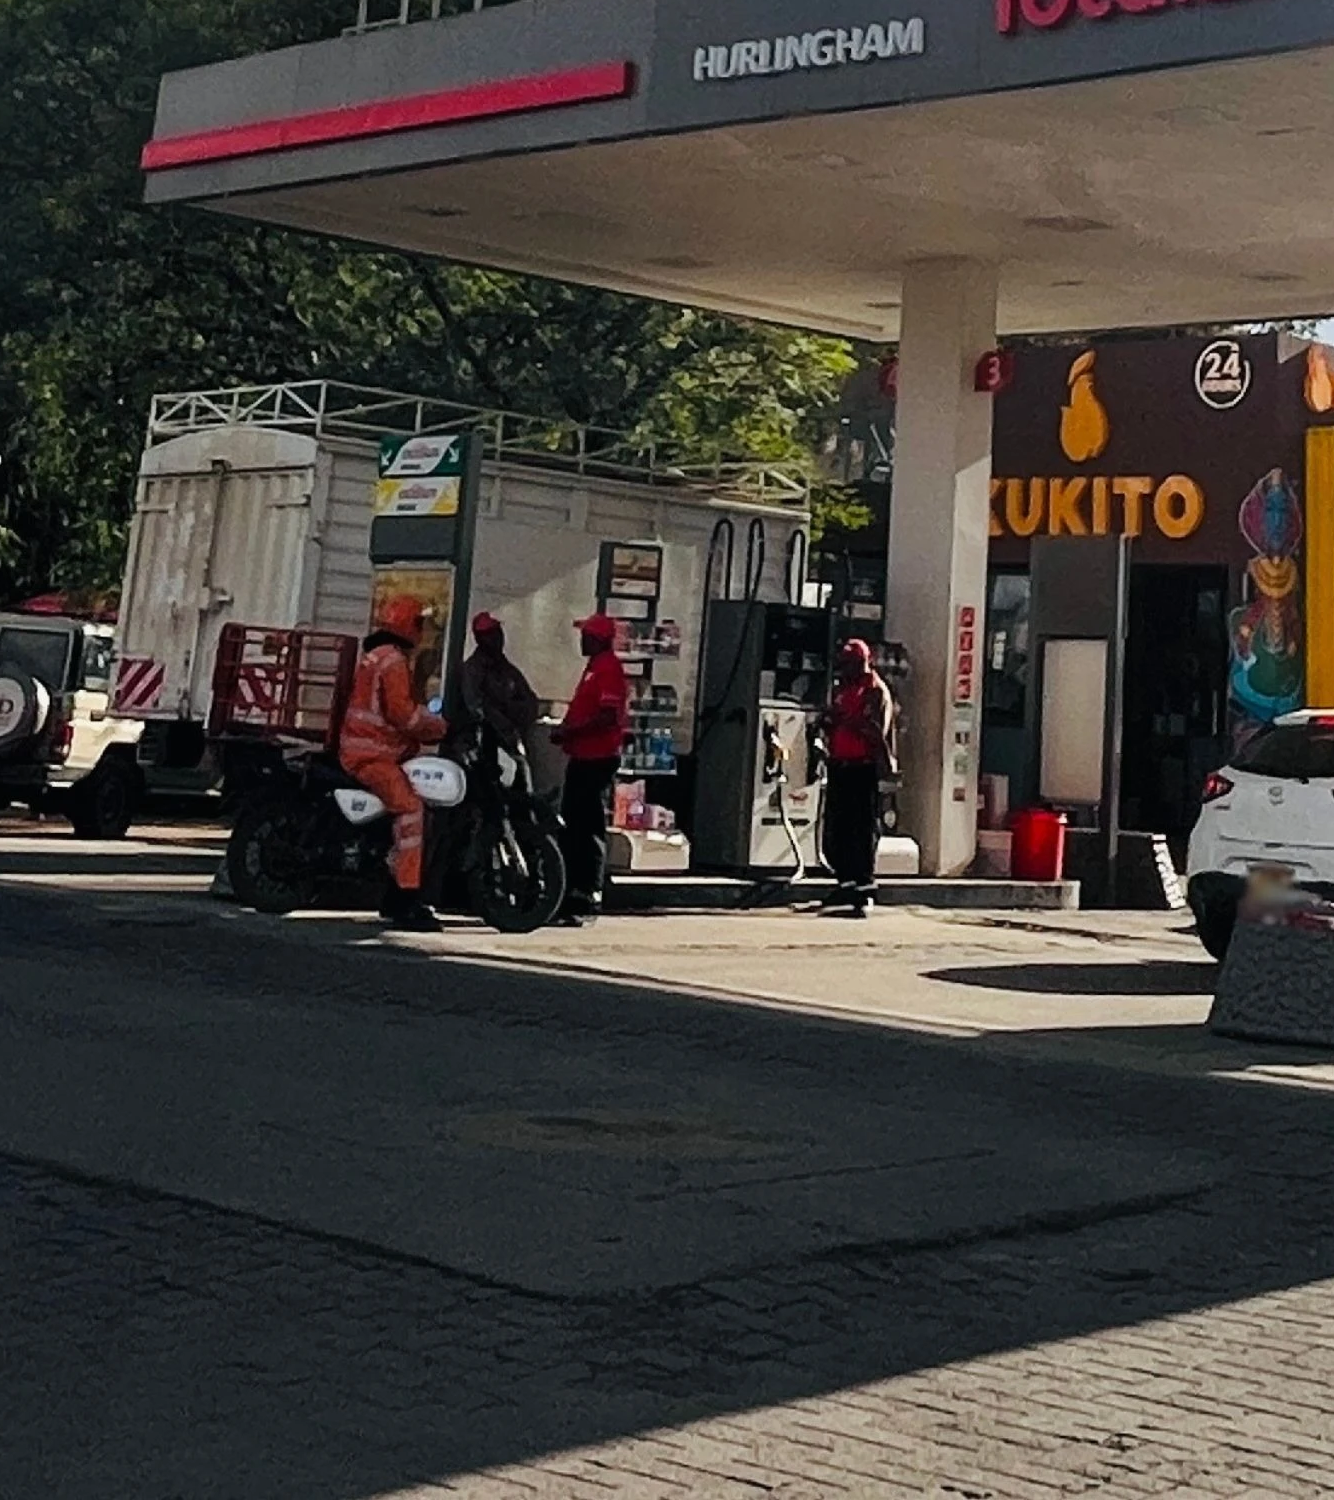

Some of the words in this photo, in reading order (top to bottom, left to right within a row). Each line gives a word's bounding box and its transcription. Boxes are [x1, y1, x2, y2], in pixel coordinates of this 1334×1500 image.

[693, 17, 925, 82] HURLINGHAM
[987, 357, 1000, 386] 3
[1205, 352, 1241, 378] 24
